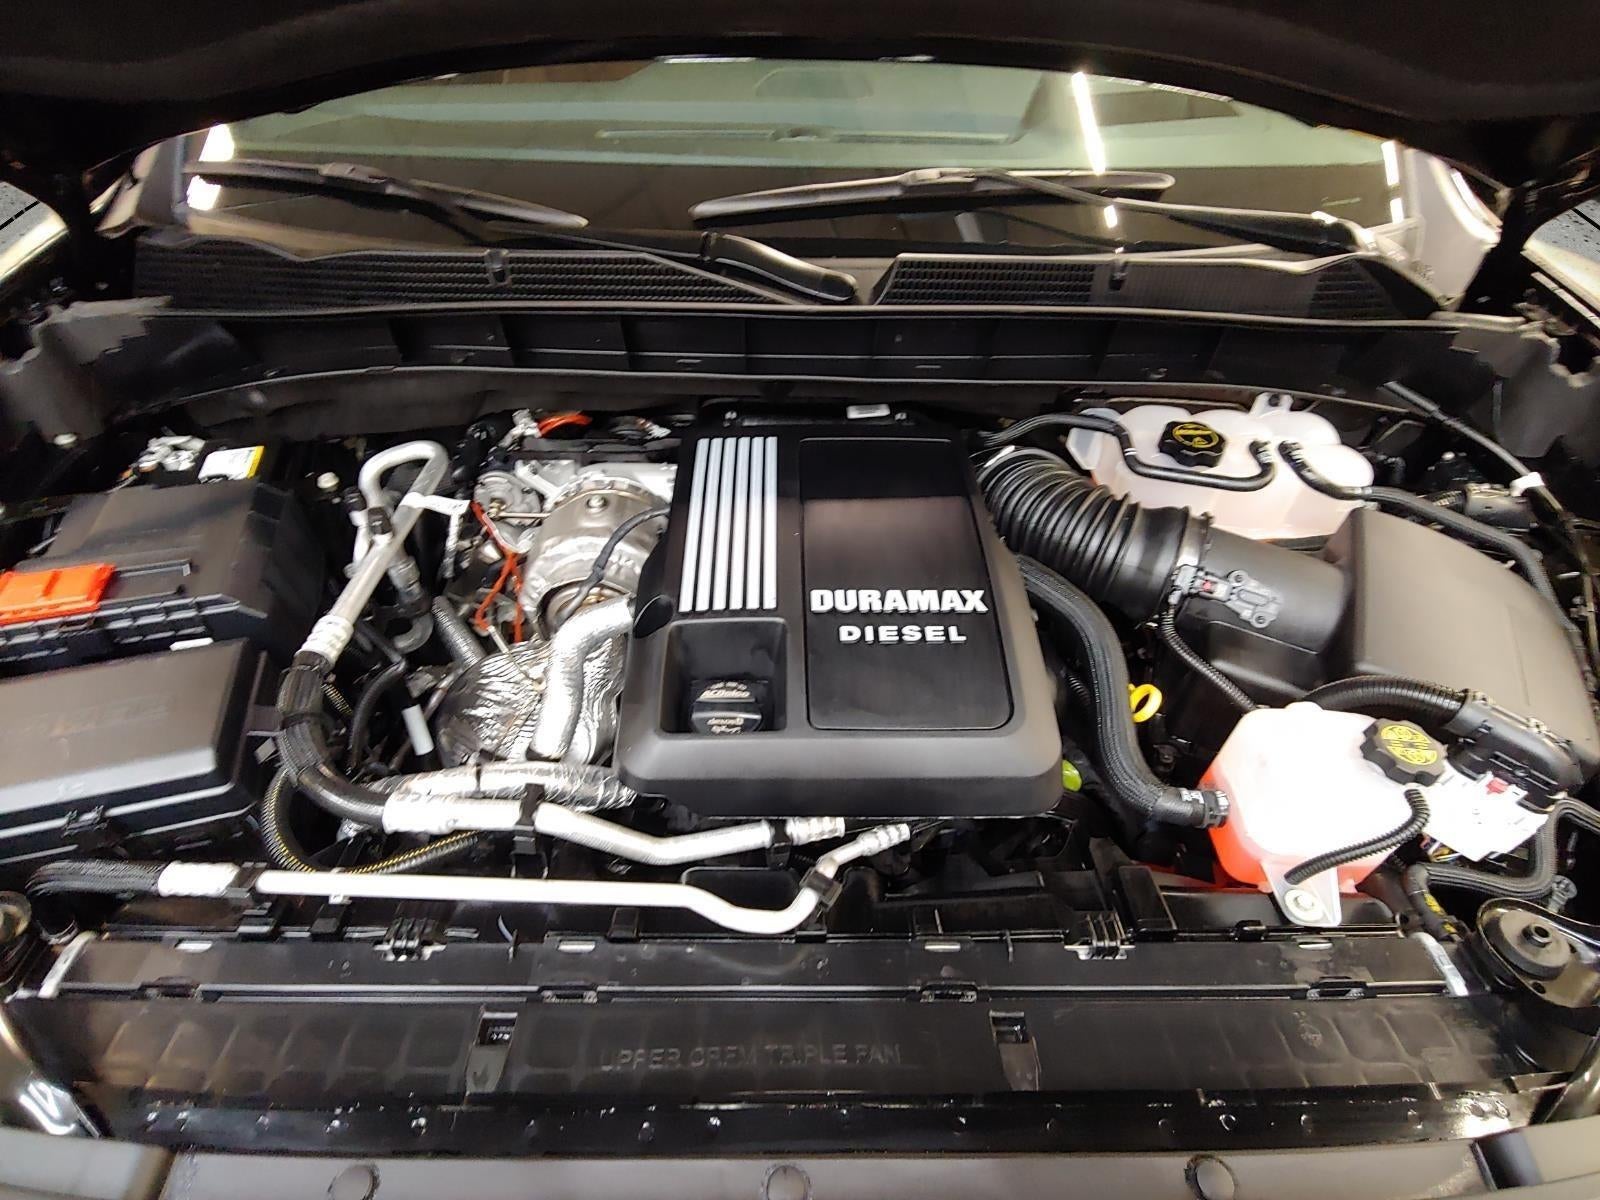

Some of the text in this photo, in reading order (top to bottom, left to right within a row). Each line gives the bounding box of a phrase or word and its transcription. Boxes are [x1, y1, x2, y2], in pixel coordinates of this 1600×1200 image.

[809, 589, 989, 614] DURAMAX
[838, 624, 968, 645] DIESEL
[600, 1047, 682, 1071] UPPER
[764, 1043, 848, 1066] TRIPLE
[855, 1043, 902, 1066] FAN
